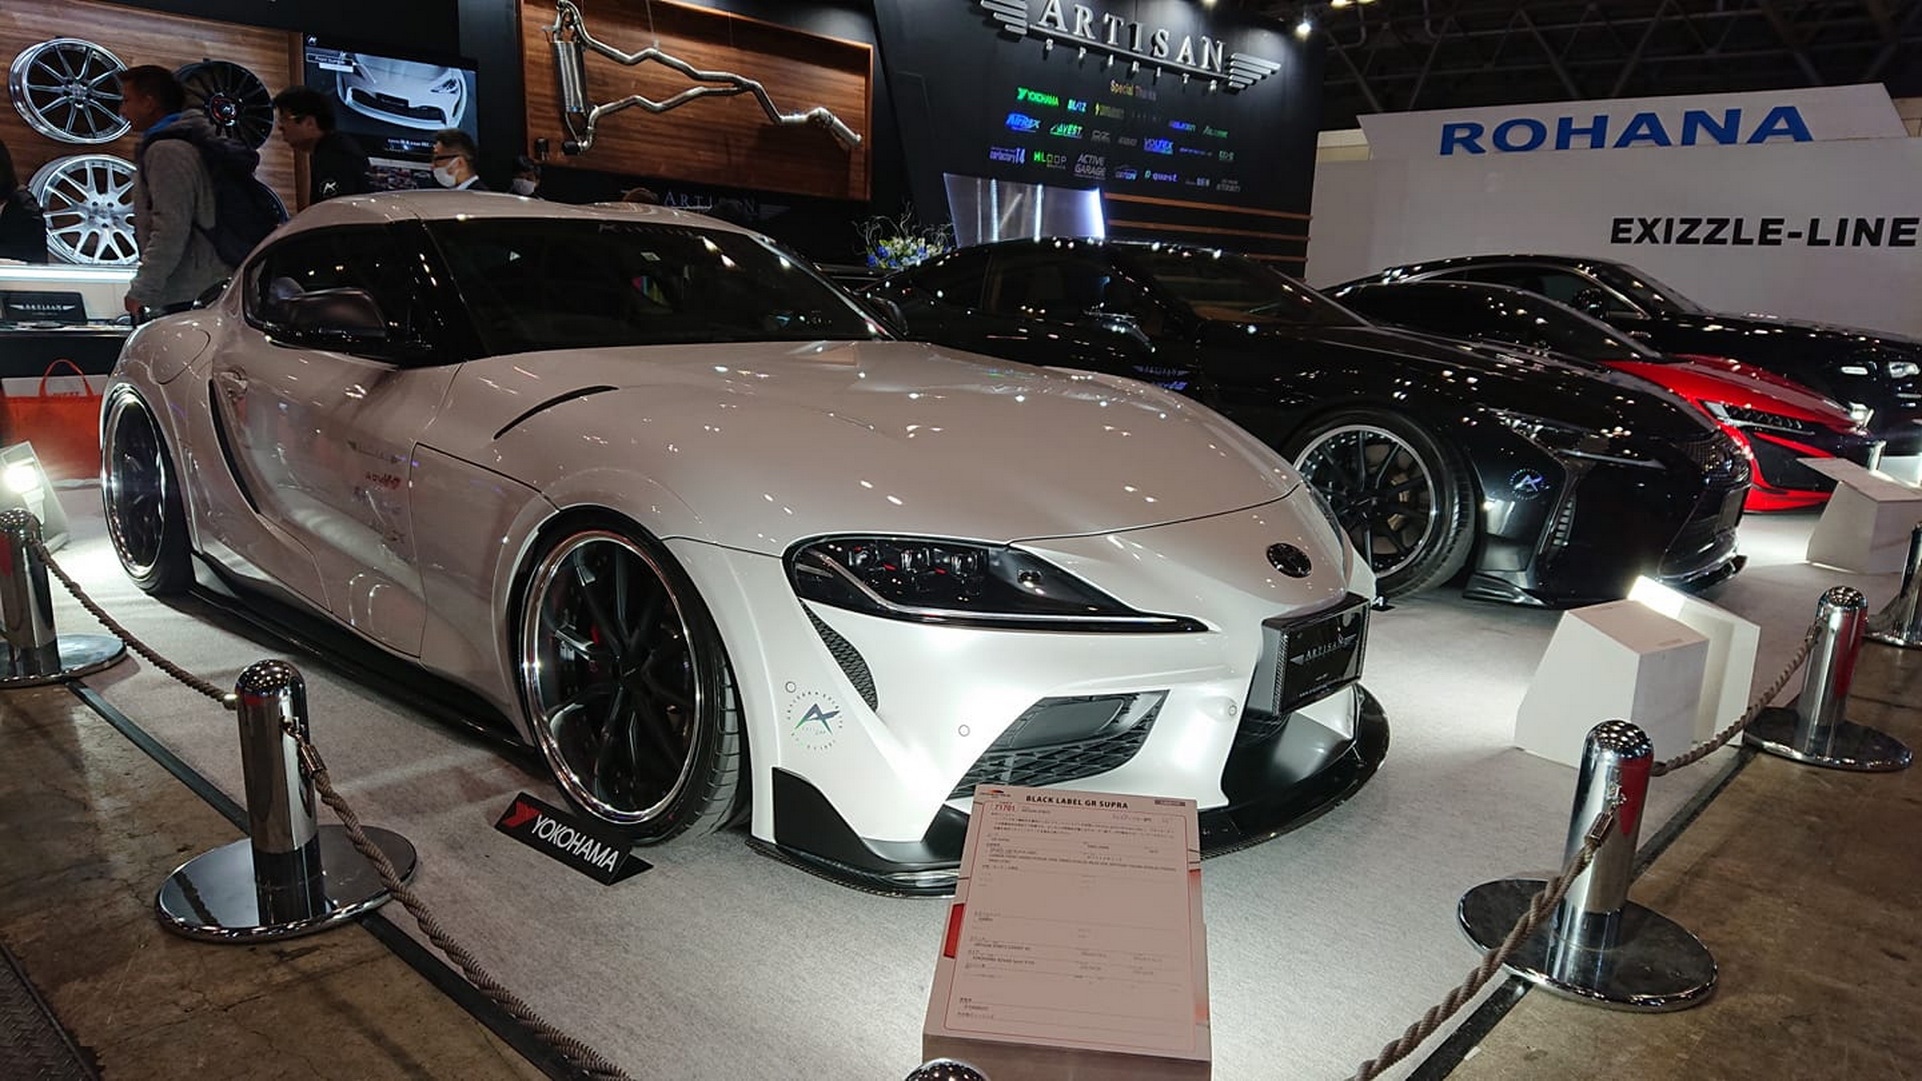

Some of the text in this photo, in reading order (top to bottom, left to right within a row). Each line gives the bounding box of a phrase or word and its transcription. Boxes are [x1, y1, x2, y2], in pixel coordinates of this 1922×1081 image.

[1037, 0, 1226, 73] ARTISAN
[1110, 80, 1134, 96] Special
[1439, 105, 1813, 156] ROHANA
[1075, 163, 1106, 176] GARAGE
[1077, 153, 1105, 166] ACTIVE
[664, 190, 756, 213] ARTIN
[1610, 217, 1920, 247] EXIZZLE-LINE
[1026, 795, 1054, 804] BLACK
[1056, 797, 1082, 806] LABEL
[1099, 801, 1128, 809] SUPRA
[531, 814, 619, 873] YOKOHAMA
